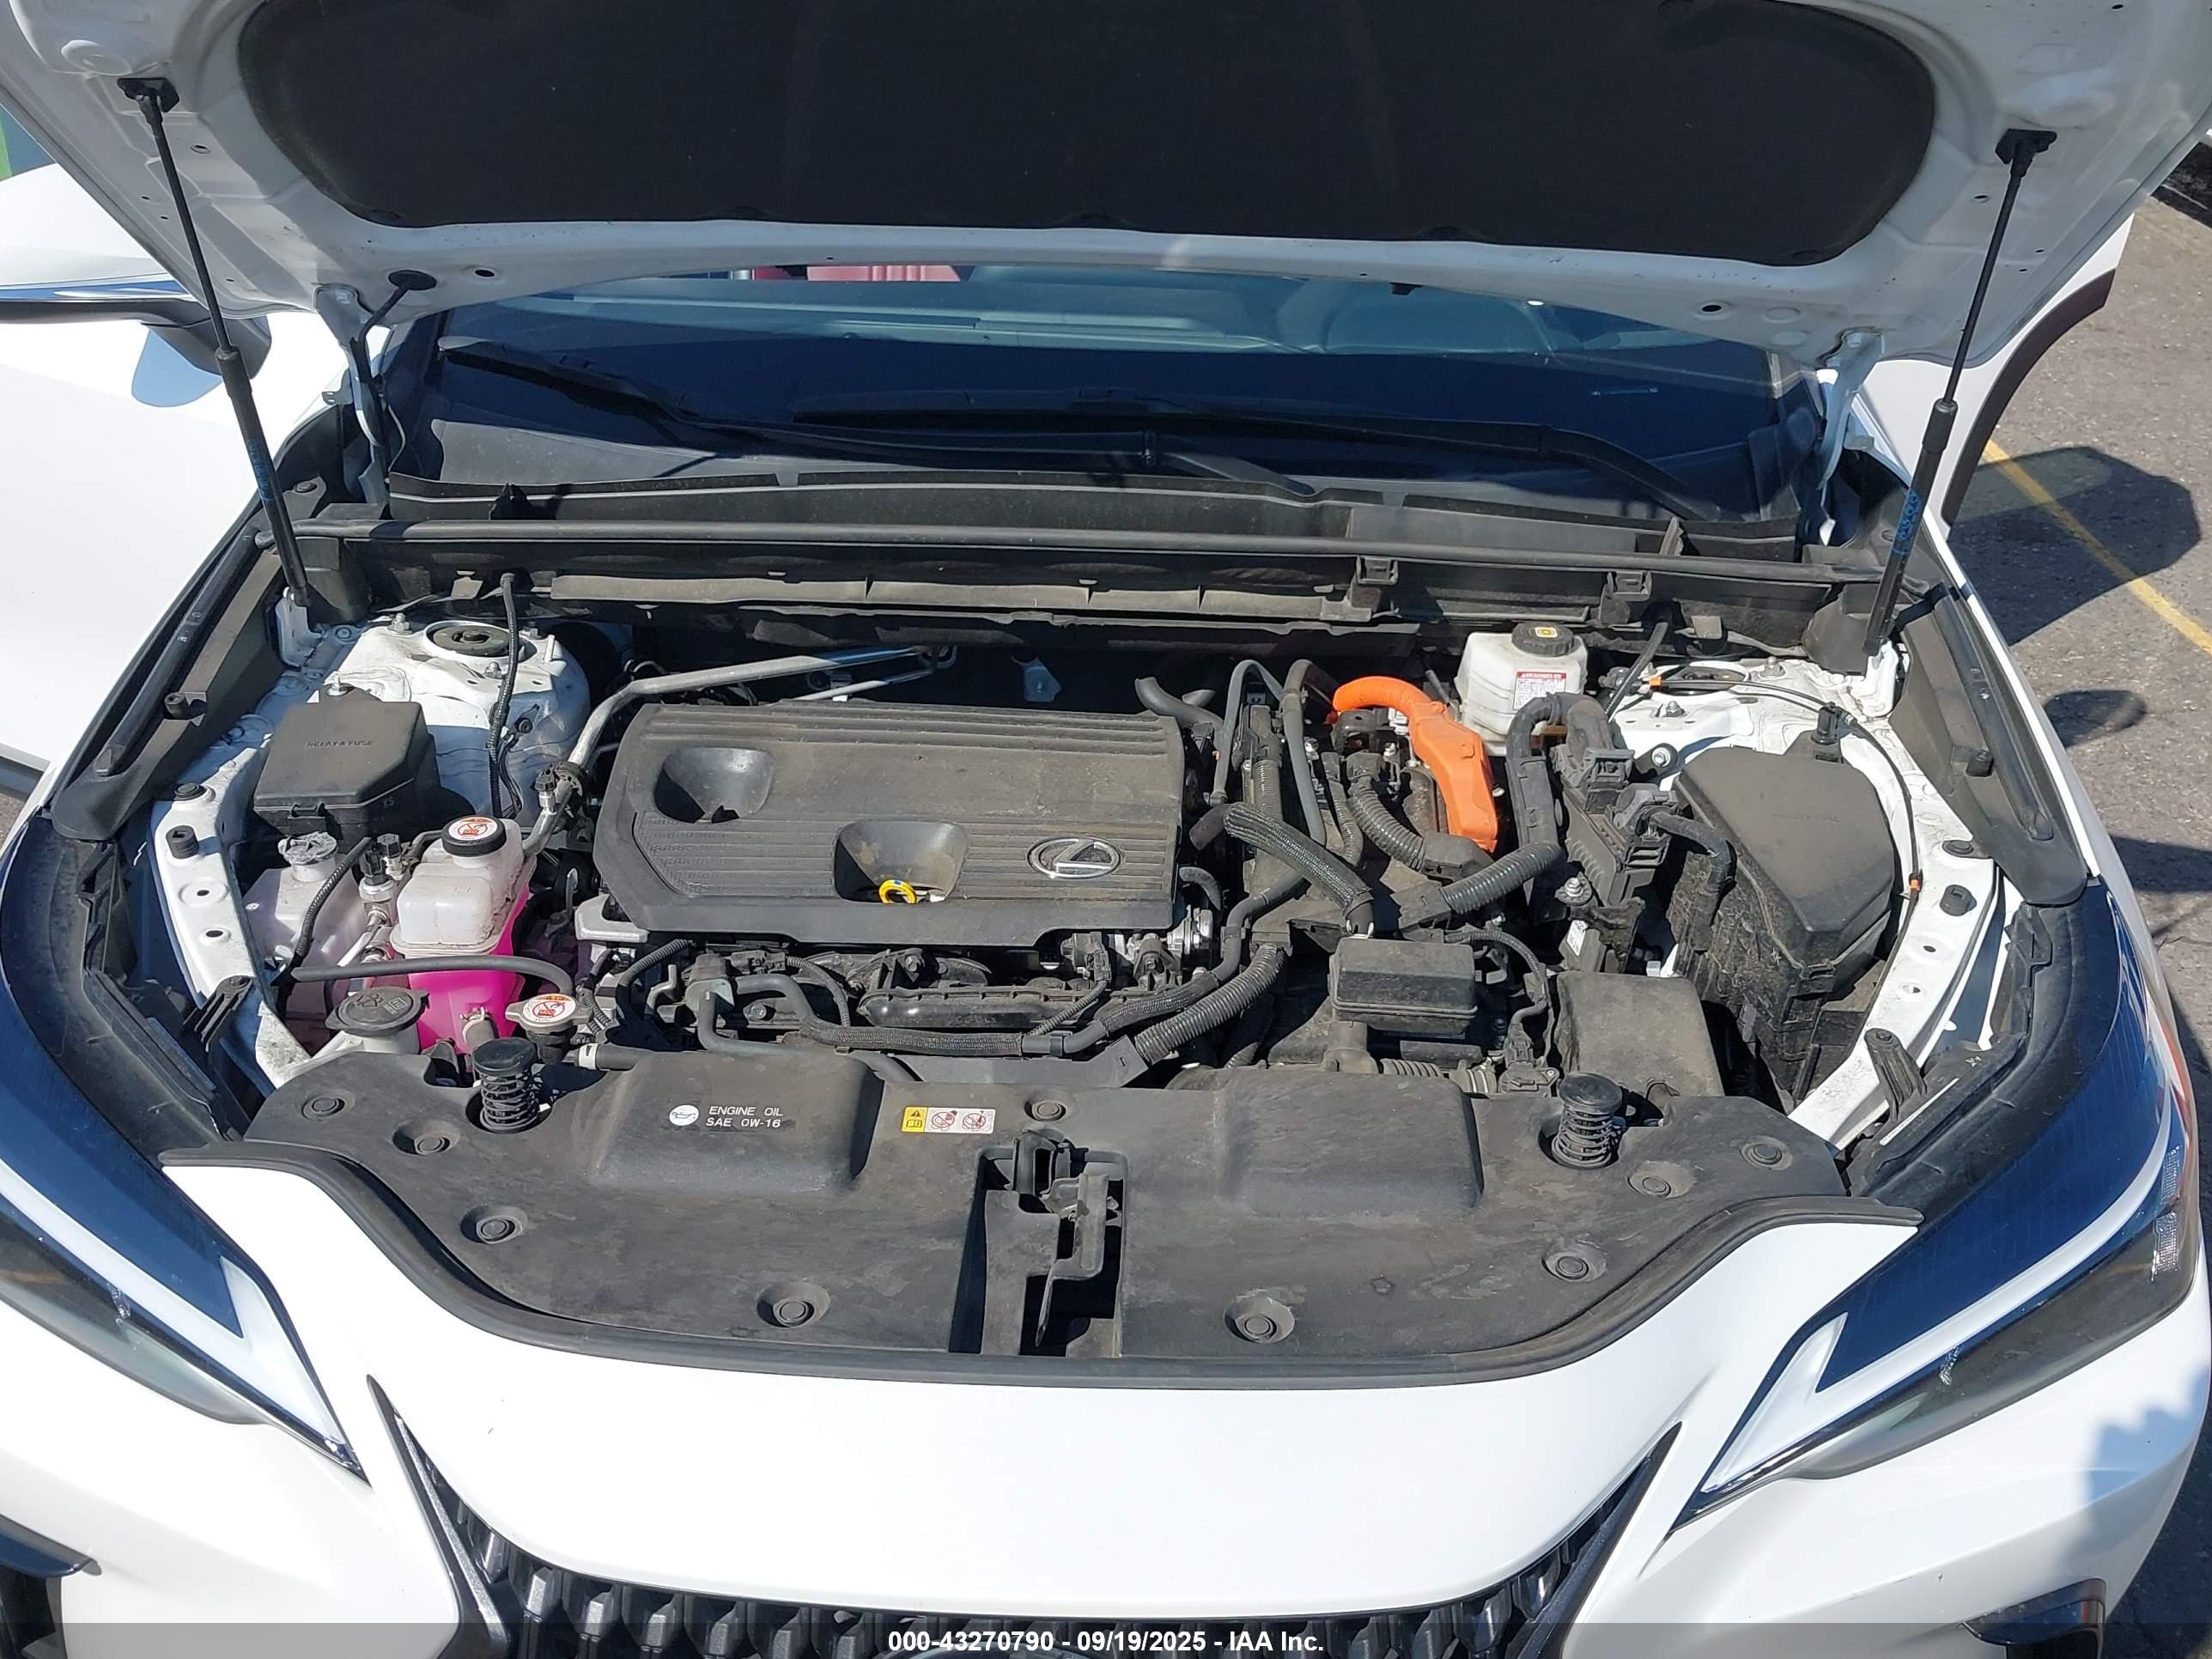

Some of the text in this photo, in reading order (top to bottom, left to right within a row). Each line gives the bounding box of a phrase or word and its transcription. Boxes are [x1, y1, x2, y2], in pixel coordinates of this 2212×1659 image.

[708, 1105, 784, 1116] ENGINE OIL
[706, 1117, 781, 1128] SAE 0W-16
